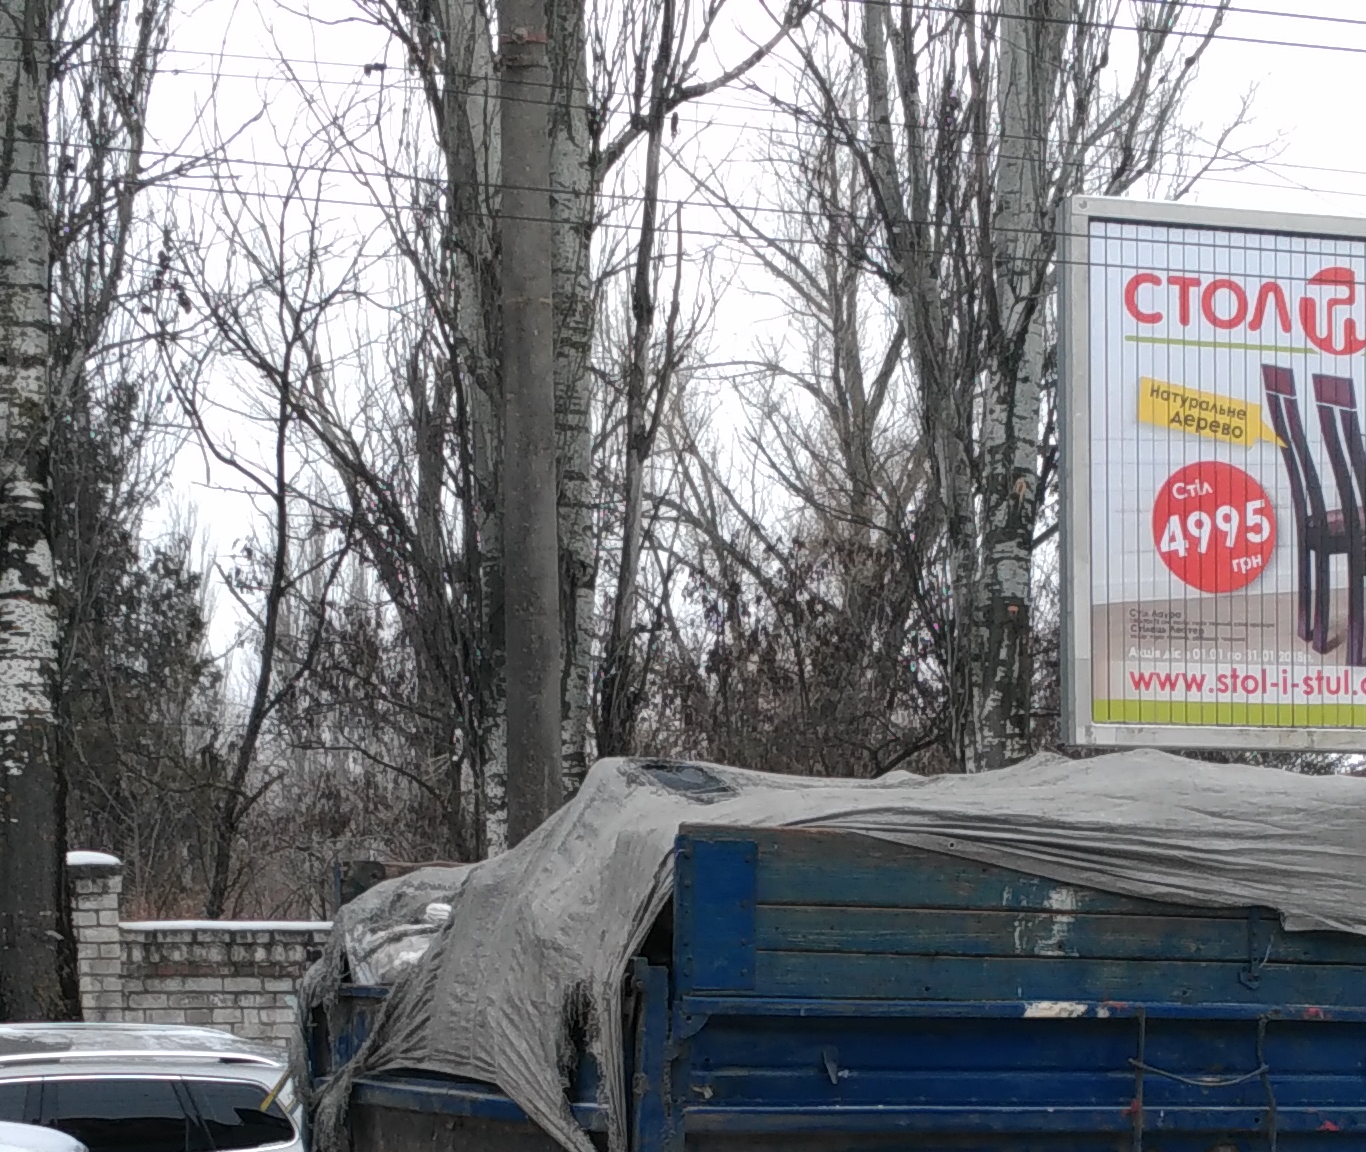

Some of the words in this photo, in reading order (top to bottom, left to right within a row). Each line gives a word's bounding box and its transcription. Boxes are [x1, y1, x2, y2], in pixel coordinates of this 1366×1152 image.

[1123, 272, 1292, 333] СТОЛ
[1149, 384, 1248, 420] Натуральне
[1169, 411, 1244, 439] дерево
[1172, 478, 1213, 499] Стіл
[1160, 499, 1271, 558] 4995
[1232, 553, 1263, 575] грн
